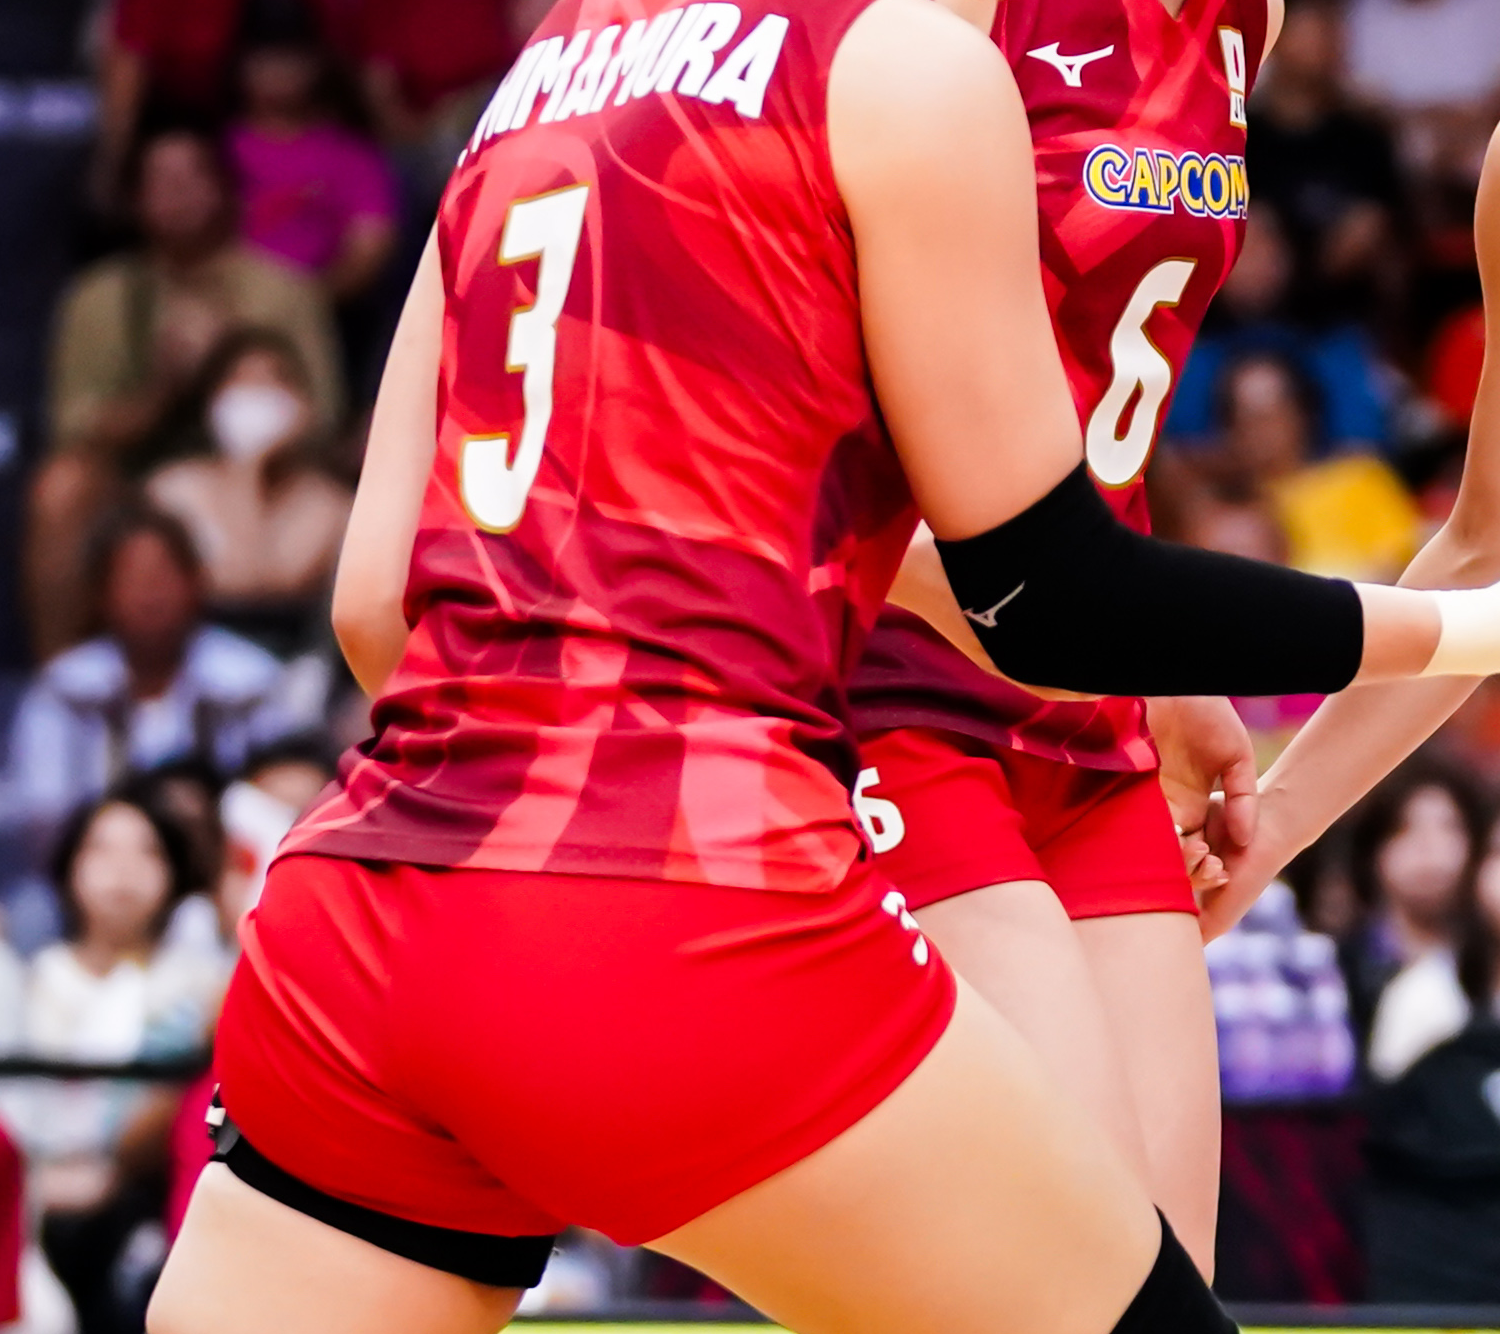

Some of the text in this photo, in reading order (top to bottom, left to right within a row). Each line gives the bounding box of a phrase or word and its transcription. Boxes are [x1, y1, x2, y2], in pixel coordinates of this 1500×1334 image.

[457, 1, 790, 167] HIMAMURA
[458, 182, 591, 534] 3
[1086, 257, 1198, 487] 6
[853, 767, 905, 854] 6
